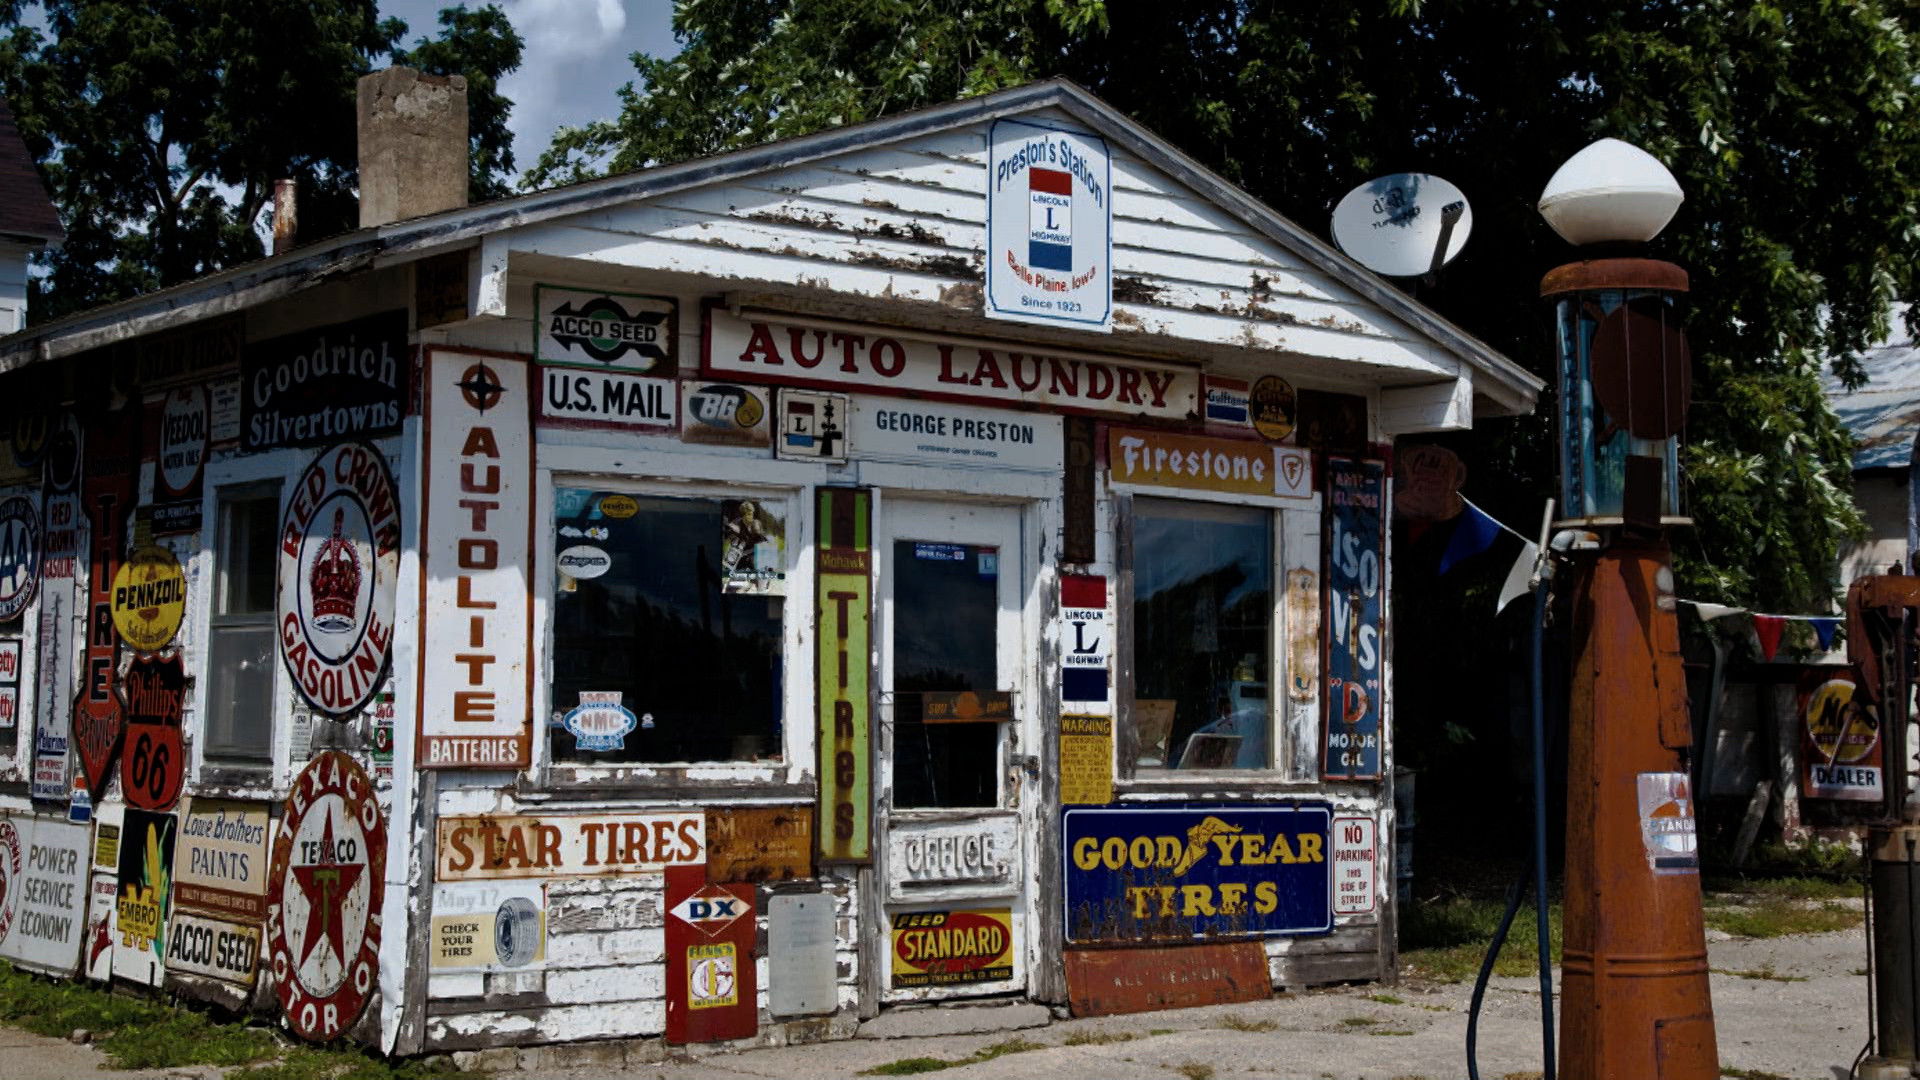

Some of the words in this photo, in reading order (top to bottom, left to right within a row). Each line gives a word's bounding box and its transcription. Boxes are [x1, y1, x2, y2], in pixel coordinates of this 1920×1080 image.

[997, 136, 1056, 192] Preston's
[1060, 140, 1103, 208] Station
[1033, 195, 1069, 207] LINCOLN
[1046, 207, 1059, 230] L
[1032, 230, 1071, 243] HIGHWAY
[1021, 295, 1053, 310] Since
[1056, 301, 1082, 312] 1923
[551, 317, 603, 338] ACCO
[609, 322, 657, 343] SEED
[253, 333, 398, 408] Goodrich
[739, 322, 906, 378] AUTO
[937, 345, 1175, 408] LAUNDRY
[549, 373, 597, 413] U.S.
[602, 379, 672, 420] MAIL
[699, 392, 741, 420] BG
[249, 400, 400, 447] Silvertowns
[794, 417, 807, 432] L
[876, 410, 947, 436] GEORGE
[952, 417, 1034, 444] PRESTON
[1118, 435, 1266, 484] Firestone
[51, 502, 71, 526] RED
[283, 466, 327, 560] RED
[334, 446, 400, 559] CROWN
[454, 427, 501, 722] AUTOLITE
[116, 576, 183, 612] PENNZOIL
[1065, 611, 1103, 620] LINCOLN
[1072, 621, 1100, 654] L
[283, 612, 391, 715] GASOLINE
[1066, 656, 1103, 665] HIGHWAY
[128, 671, 179, 729] Phillips
[580, 712, 621, 730] NMC
[827, 590, 859, 842] TIRES
[1061, 718, 1111, 733] WARNING
[430, 738, 519, 764] BATTERIES
[1329, 732, 1377, 749] MOTOR
[132, 733, 170, 800] 66
[1340, 753, 1365, 767] OIL
[1816, 767, 1876, 786] DEALER
[278, 756, 378, 840] TEXACO
[183, 807, 213, 838] Lowe
[213, 806, 264, 845] Brothers
[1344, 825, 1363, 844] NO
[29, 845, 78, 875] POWER
[300, 838, 358, 865] TEXACO
[449, 823, 563, 873] STAR
[580, 818, 701, 866] TIRES
[906, 834, 995, 874] OFFICE
[1072, 835, 1183, 871] GOOD
[1212, 833, 1325, 867] YEAR
[1335, 849, 1373, 862] PARKING
[191, 847, 250, 882] PAINTS
[24, 877, 75, 910] SERVICE
[440, 890, 475, 912] May
[480, 889, 499, 907] 17
[1126, 881, 1279, 919] TIRES
[1341, 895, 1367, 905] STREET
[120, 902, 157, 926] EMBRO
[689, 900, 737, 920] DX
[897, 912, 946, 928] FEED
[20, 909, 72, 944] ECONOMY
[441, 923, 479, 934] CHECK
[441, 935, 473, 946] YOUR
[169, 923, 214, 966] ACCO
[216, 931, 257, 974] SEED
[440, 947, 473, 958] TIRES
[904, 925, 1003, 961] STANDARD
[269, 903, 340, 1034] MOTOR
